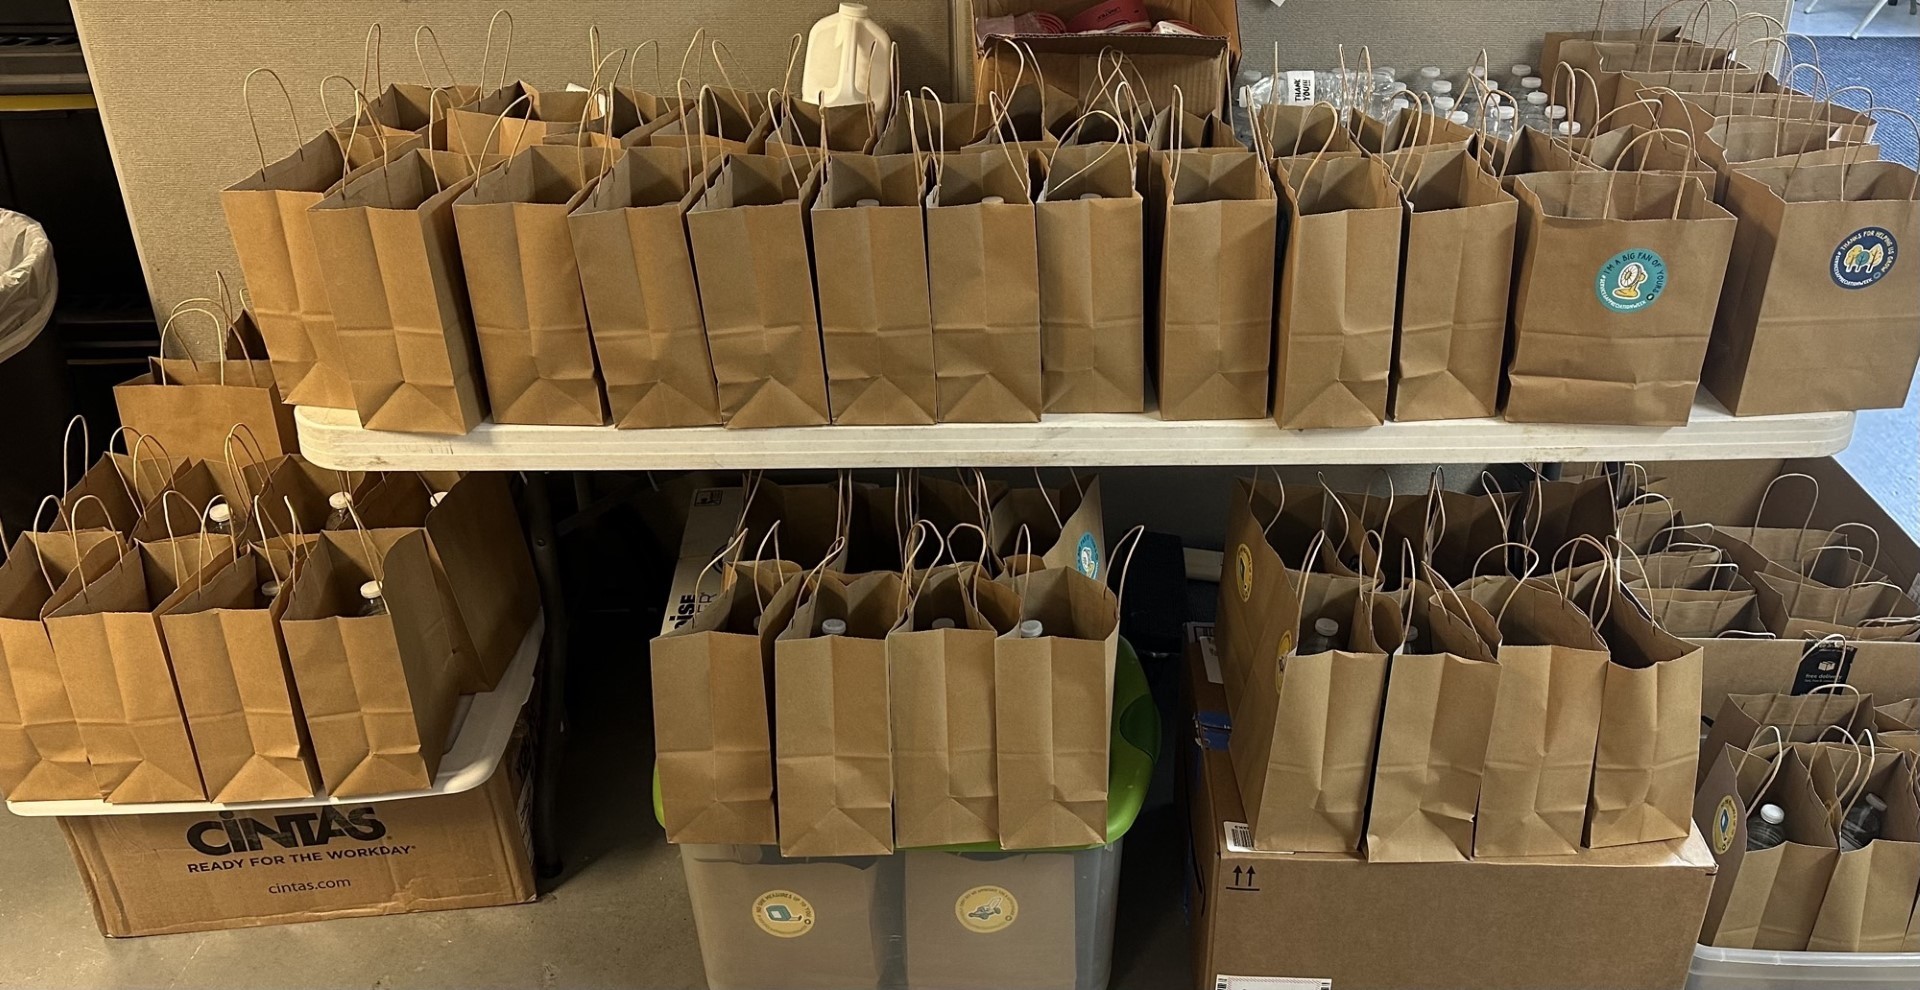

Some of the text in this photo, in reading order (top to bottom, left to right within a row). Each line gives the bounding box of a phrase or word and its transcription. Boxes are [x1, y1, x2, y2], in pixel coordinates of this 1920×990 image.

[1840, 232, 1862, 250] THANKS
[1875, 231, 1893, 247] HELPING
[1622, 252, 1636, 262] BIG
[1637, 252, 1653, 262] FAN
[1887, 246, 1895, 255] US
[1651, 259, 1662, 268] OF
[1881, 255, 1893, 273] GROW
[1652, 270, 1664, 294] YOURS
[187, 859, 244, 873] READY
[249, 855, 285, 867] FOR
[289, 851, 323, 864] THE
[268, 879, 351, 894] cintas.com
